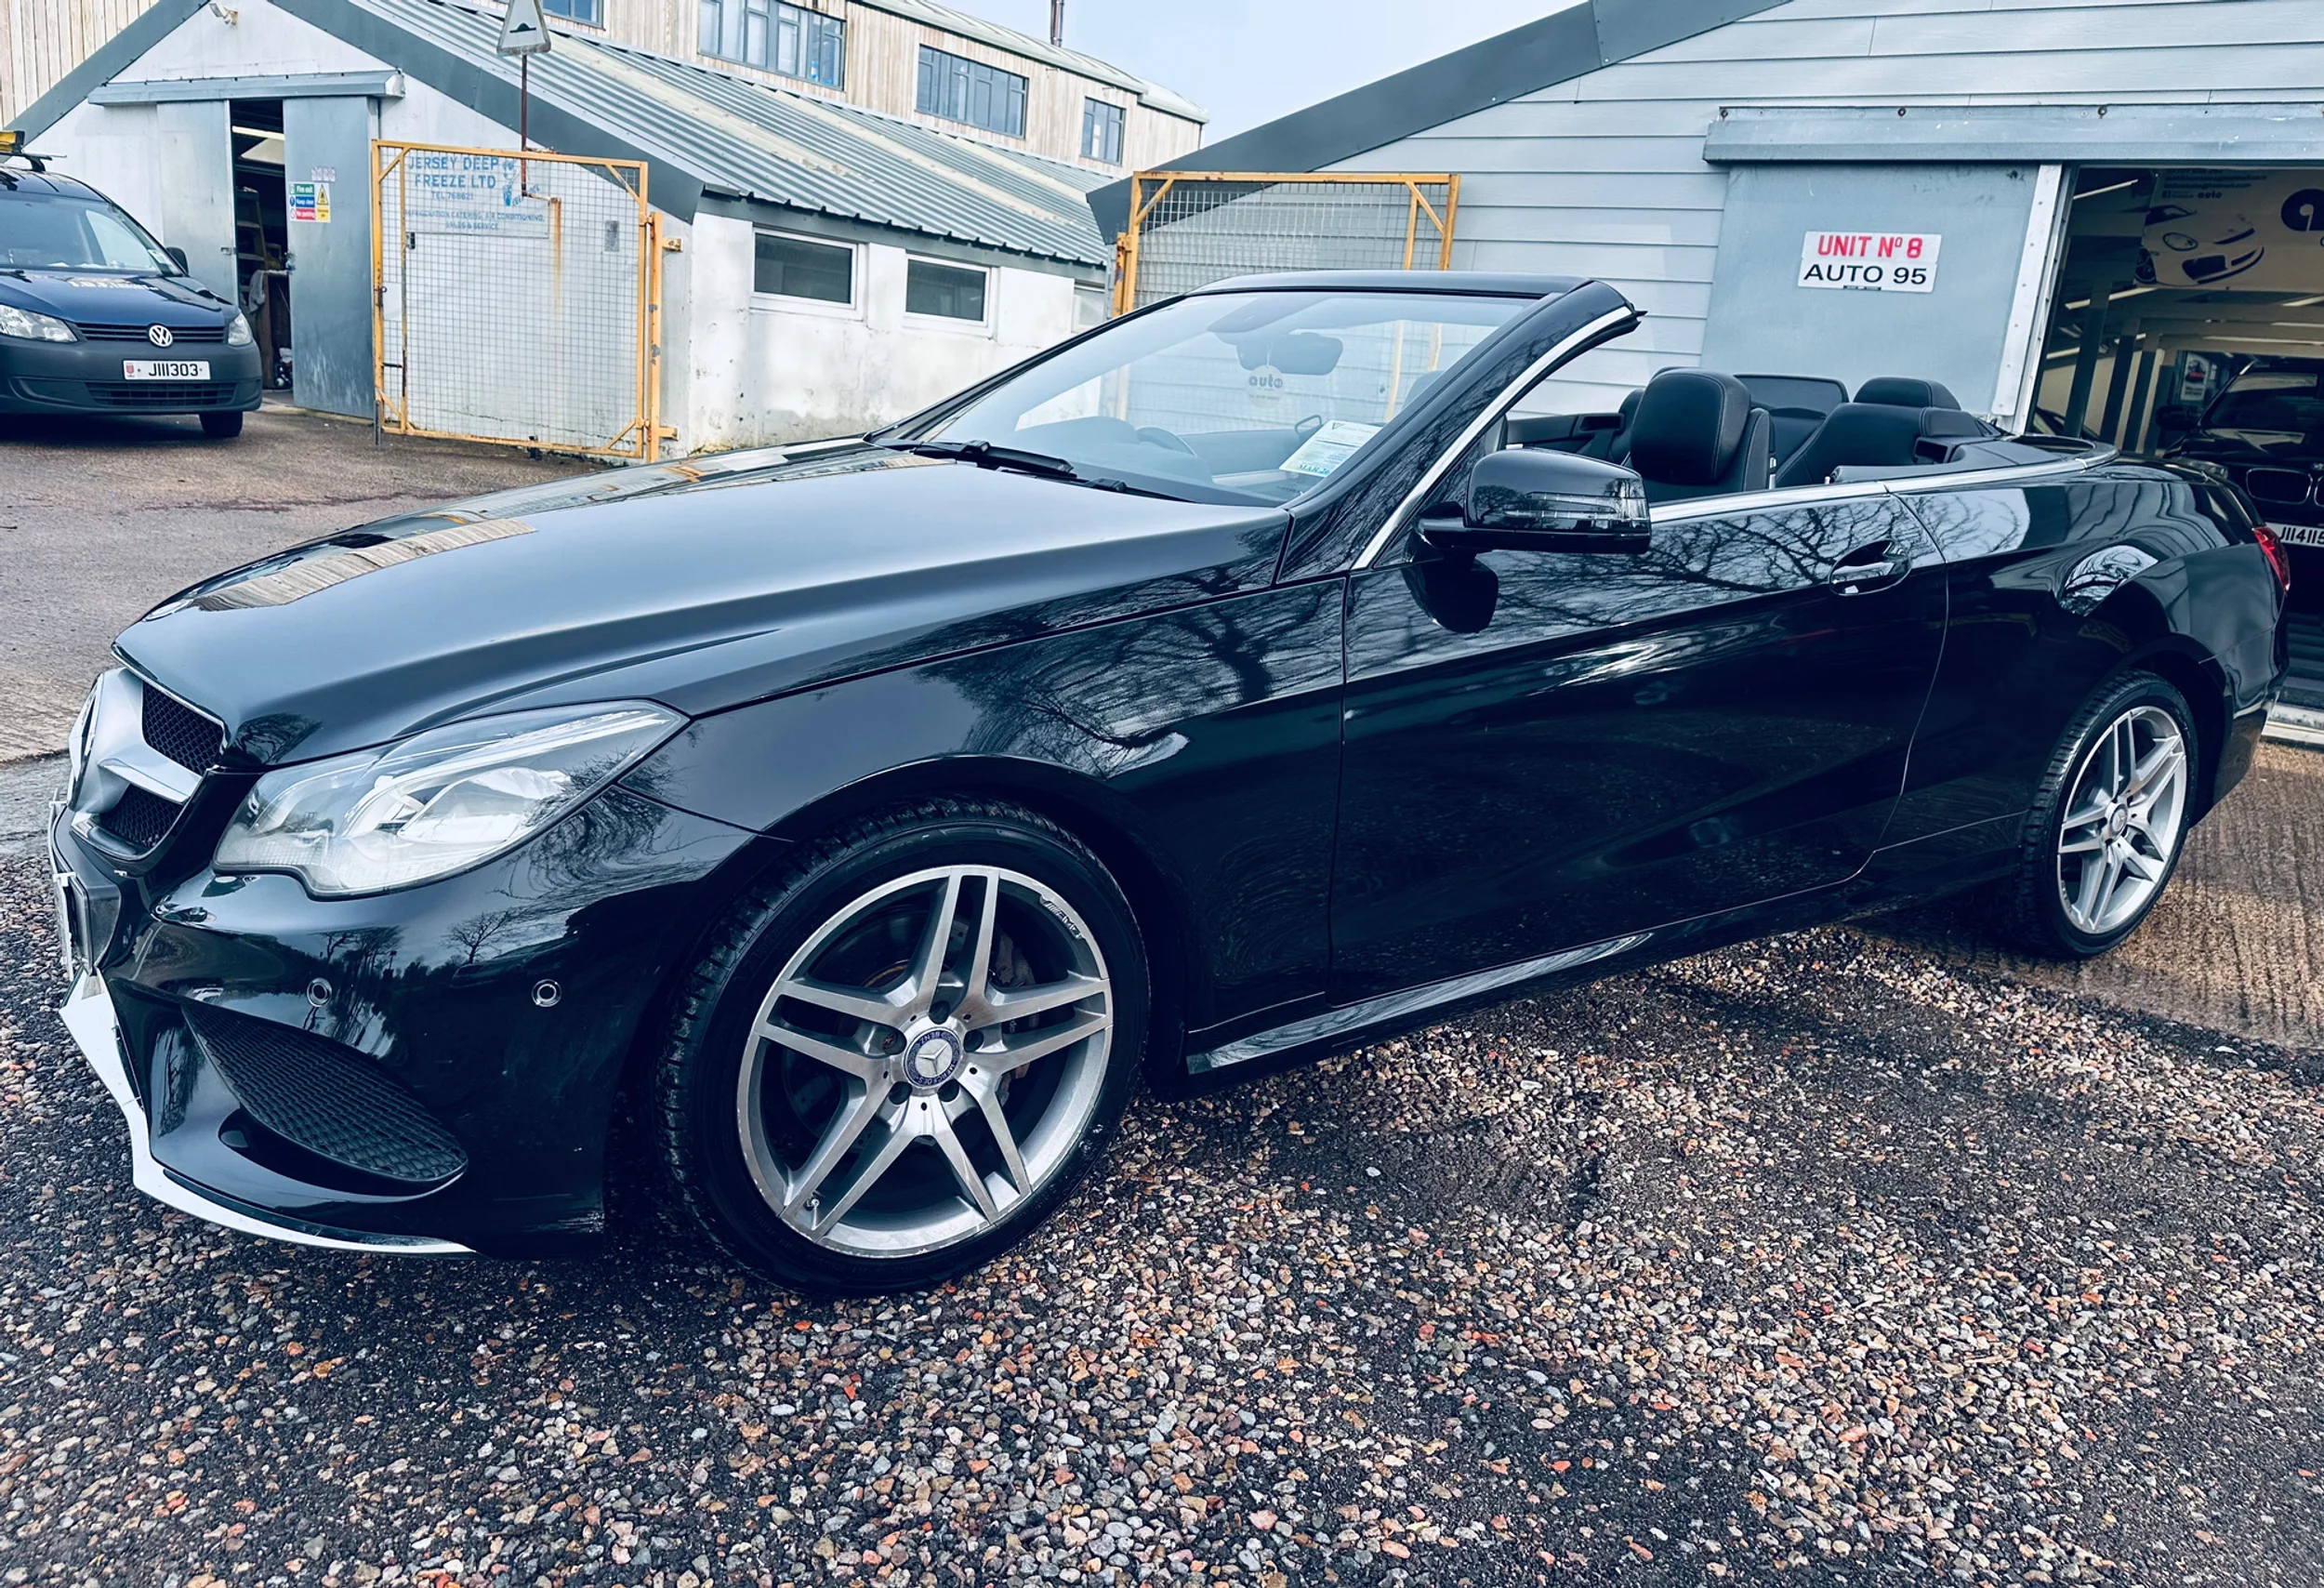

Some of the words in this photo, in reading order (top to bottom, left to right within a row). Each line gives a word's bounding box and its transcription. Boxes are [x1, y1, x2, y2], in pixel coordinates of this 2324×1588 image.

[408, 156, 456, 170] JERSEY
[463, 156, 500, 171] DEEP
[415, 174, 467, 188] FREEZE
[470, 175, 496, 189] LTD
[1817, 234, 1872, 258] UNIT
[1907, 237, 1923, 258] 8
[1803, 263, 1883, 283] AUTO
[1893, 267, 1927, 285] 95
[1248, 373, 1283, 389] auto
